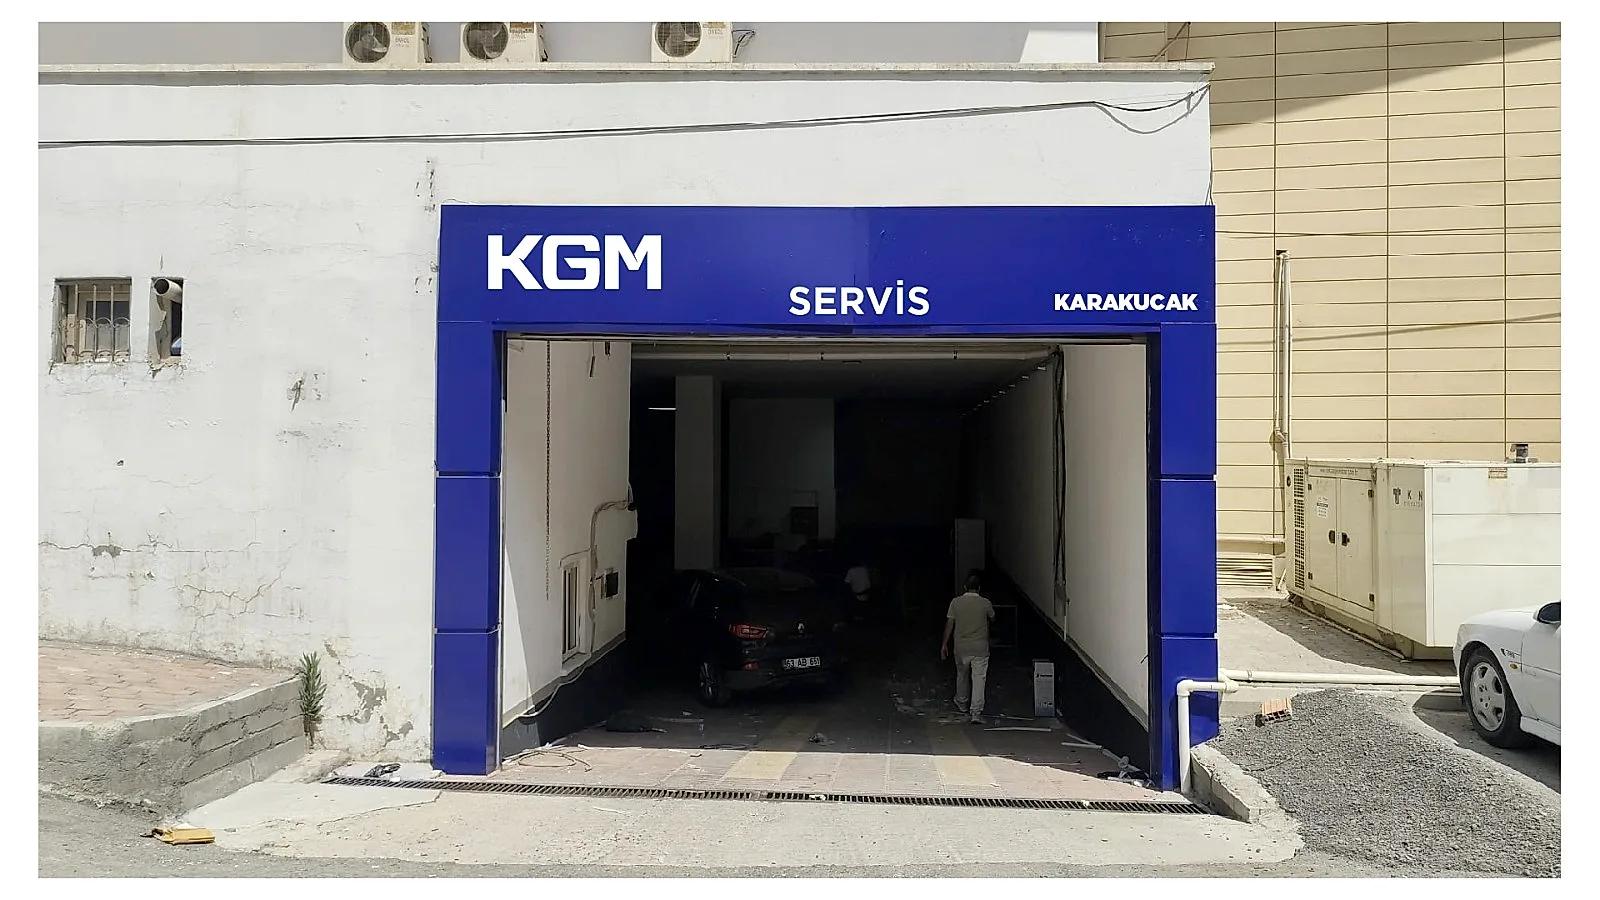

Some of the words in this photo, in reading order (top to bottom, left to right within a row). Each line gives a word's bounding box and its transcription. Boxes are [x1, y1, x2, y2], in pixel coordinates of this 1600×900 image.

[487, 234, 662, 290] KGM
[788, 279, 930, 316] SERVİS
[1054, 293, 1198, 311] KARAKUCAK
